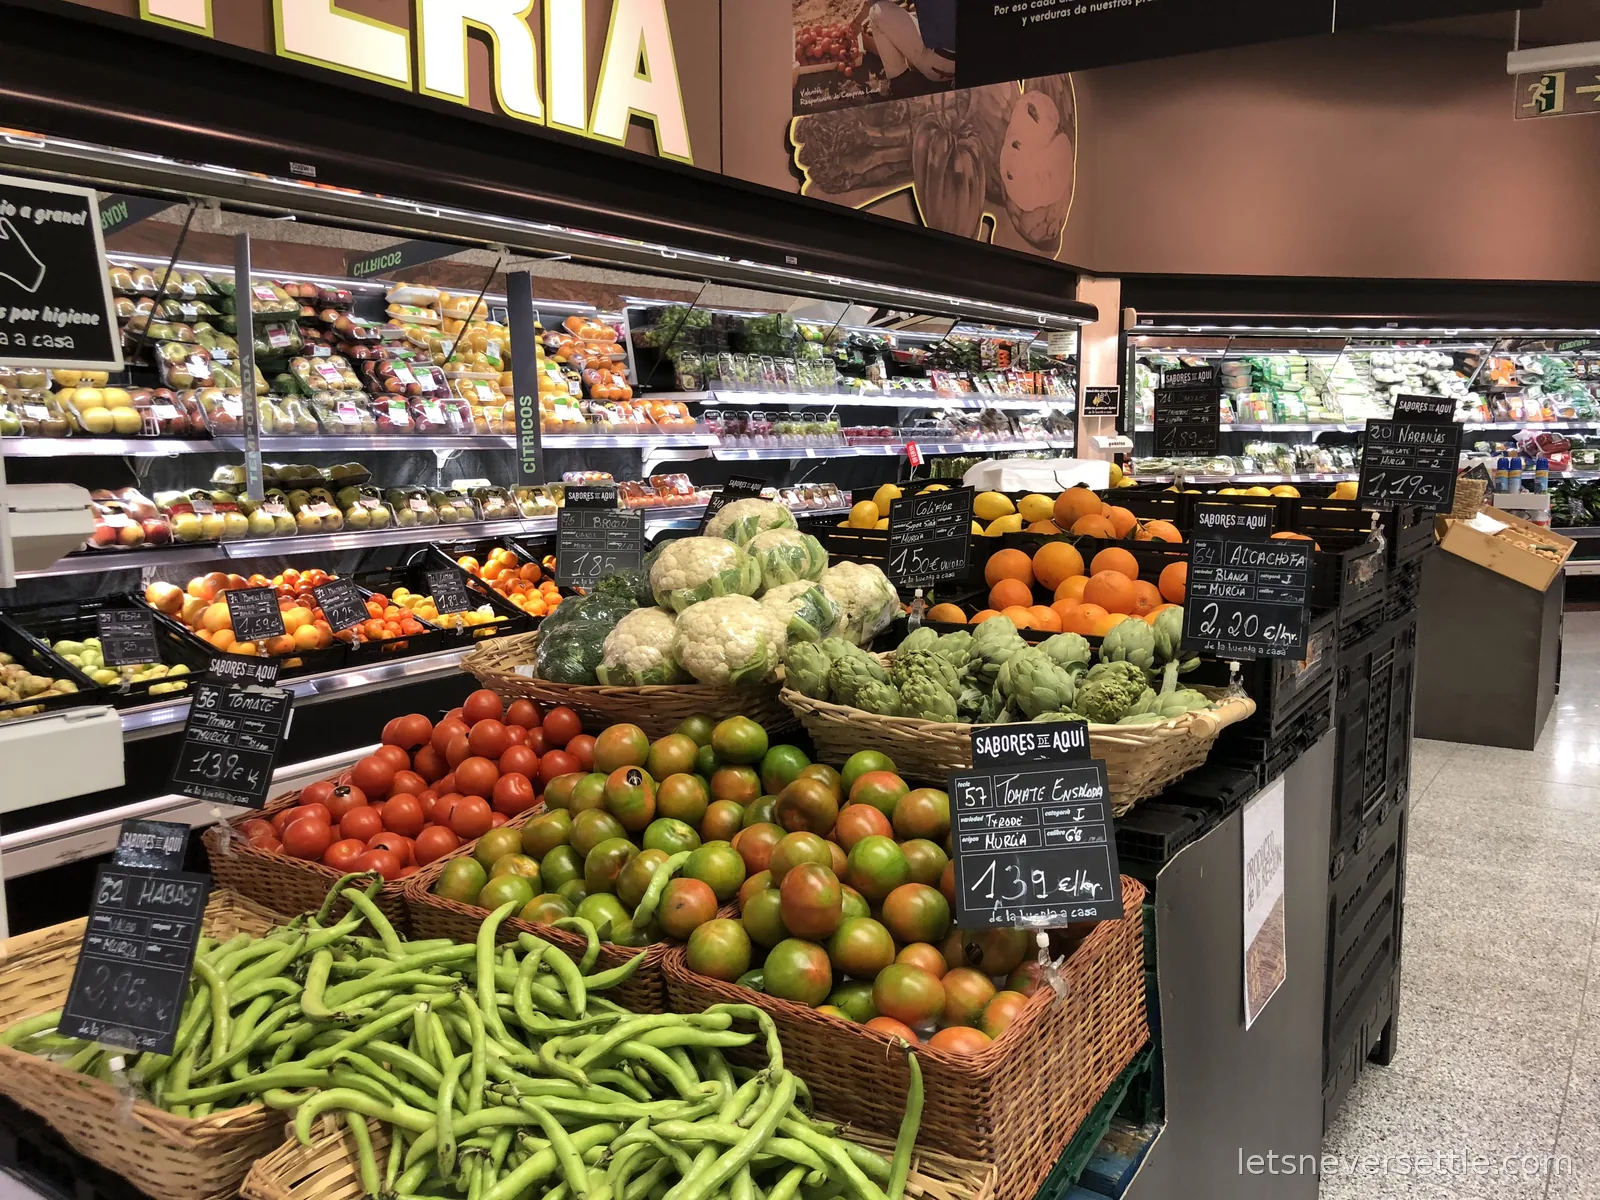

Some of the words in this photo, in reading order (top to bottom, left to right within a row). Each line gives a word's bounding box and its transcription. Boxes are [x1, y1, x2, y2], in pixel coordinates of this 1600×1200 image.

[994, 5, 1009, 16] Por
[1012, 3, 1028, 13] eso
[1021, 16, 1028, 27] y
[1030, 9, 1072, 24] verduras
[1074, 4, 1088, 16] de
[1090, 0, 1133, 13] nuestros
[20, 205, 32, 219] a
[34, 208, 88, 226] granel
[8, 306, 40, 324] por
[42, 305, 100, 328] higiene
[14, 332, 27, 346] a
[32, 334, 75, 348] casa
[1166, 373, 1191, 385] SABORES
[1399, 400, 1428, 413] SABORES
[243, 354, 258, 485] TEMPORADA
[523, 395, 537, 475] CÍTRICOS
[568, 491, 594, 502] SABORES
[601, 491, 615, 502] AQUÍ
[1199, 513, 1236, 529] SABORES
[1246, 514, 1267, 530] AQUÍ
[1230, 544, 1305, 567] ALCACHOFA
[1215, 568, 1249, 583] BLANCA
[1200, 602, 1259, 639] 2,20
[1204, 641, 1215, 651] de
[1265, 648, 1287, 657] casa
[209, 658, 247, 678] SABORES
[255, 664, 279, 682] AQUÍ
[196, 691, 219, 708] 56
[976, 733, 1036, 757] SABORES
[1037, 735, 1050, 748] DE
[1053, 726, 1085, 752] AQUÍ
[964, 787, 987, 807] 57
[996, 774, 1046, 806] TOMATE
[122, 832, 155, 854] SABORES
[137, 880, 198, 907] HABAS
[988, 909, 1003, 923] de
[1005, 909, 1017, 922] la
[1059, 909, 1068, 919] a
[1070, 907, 1098, 918] casa
